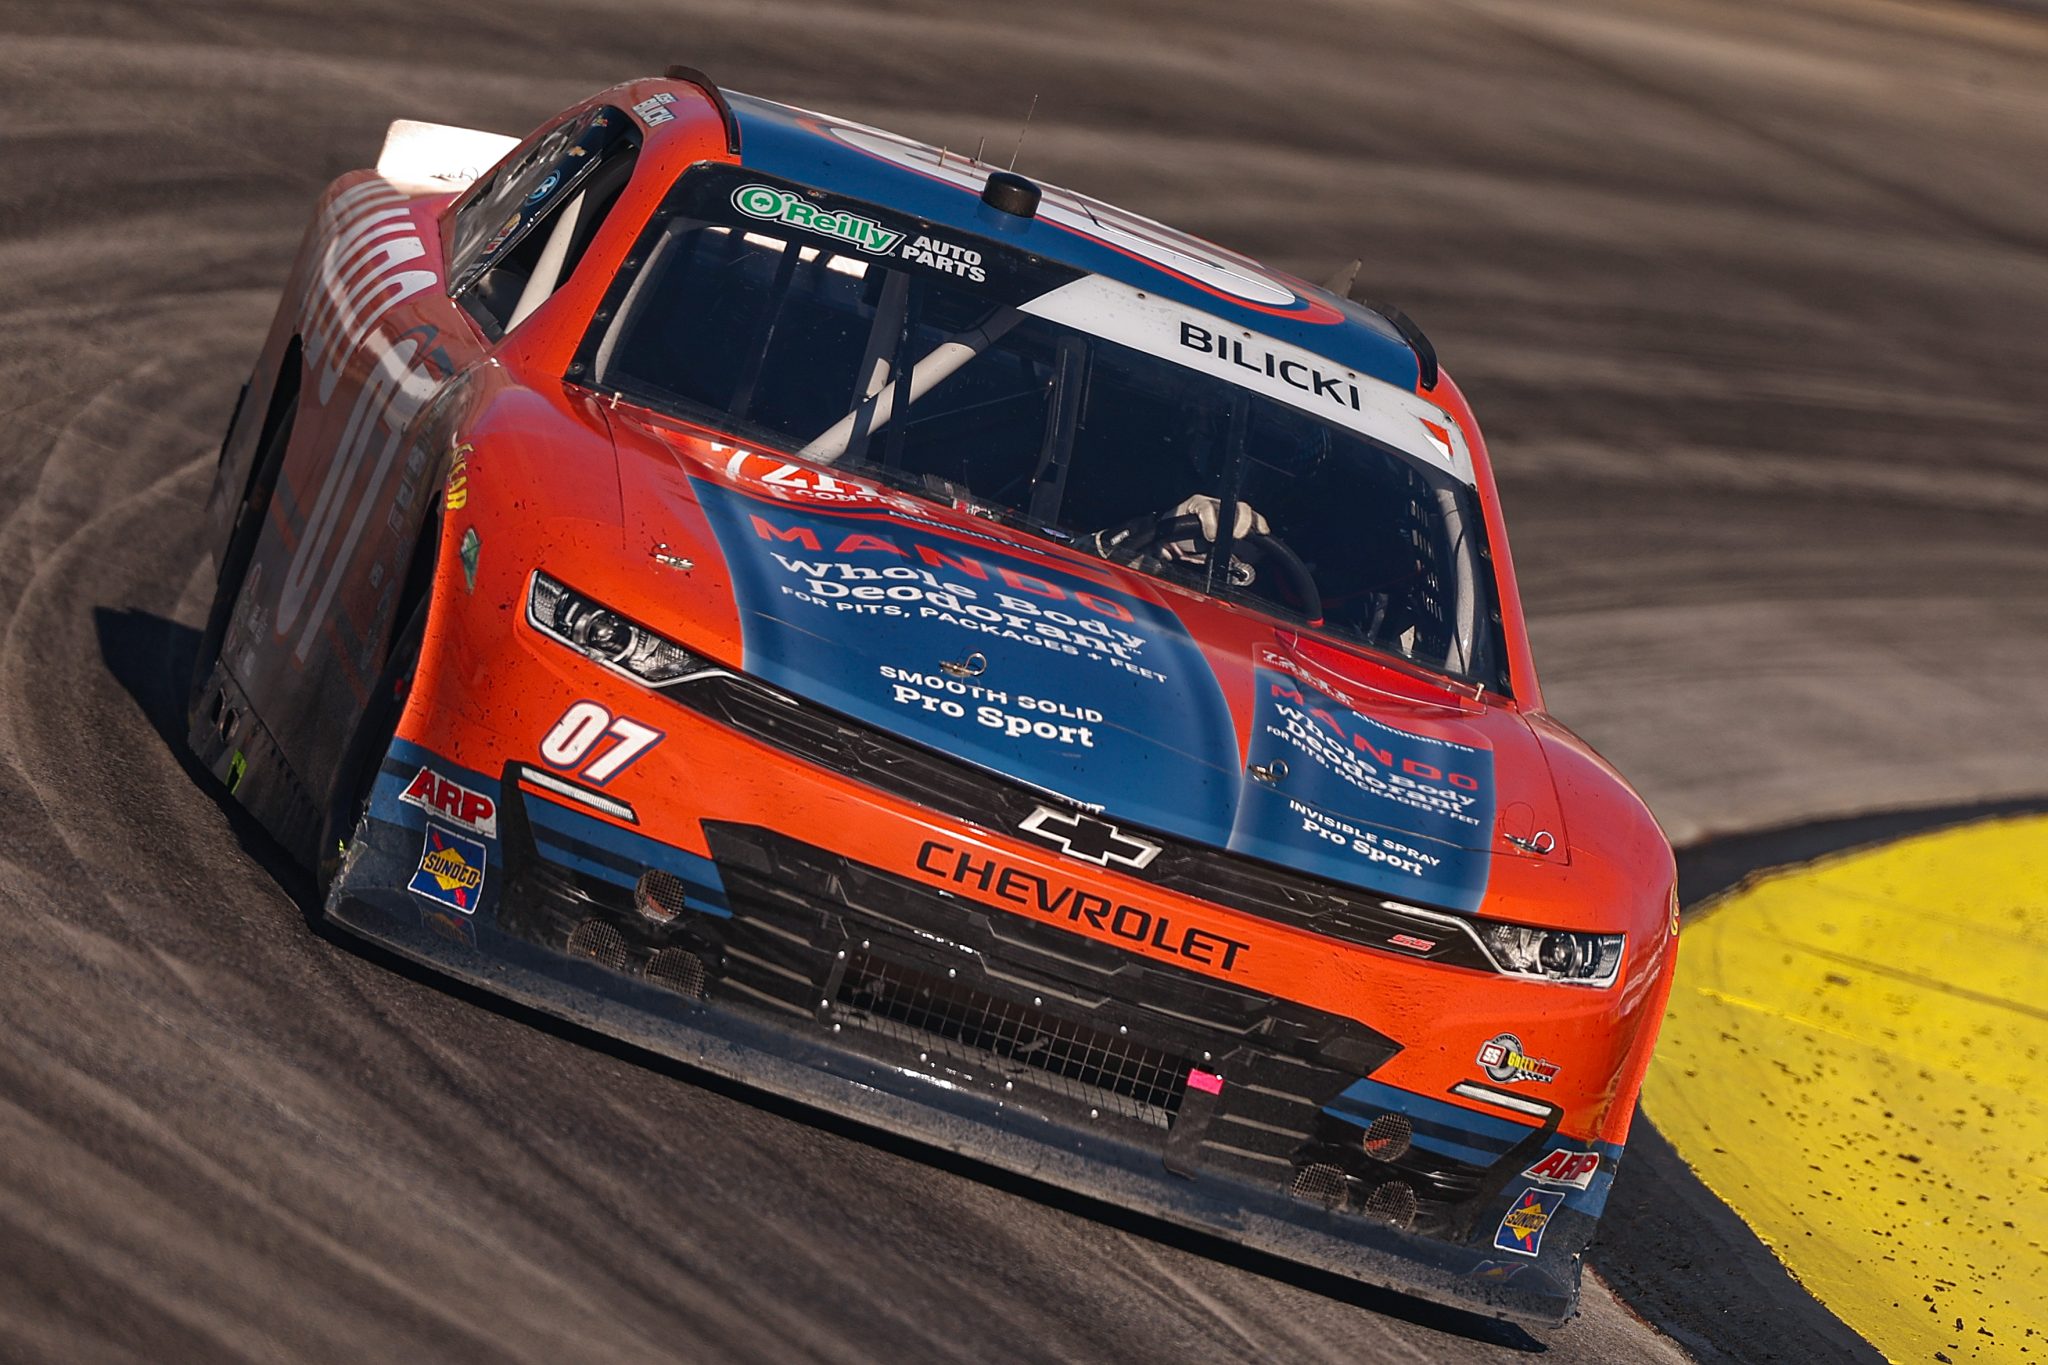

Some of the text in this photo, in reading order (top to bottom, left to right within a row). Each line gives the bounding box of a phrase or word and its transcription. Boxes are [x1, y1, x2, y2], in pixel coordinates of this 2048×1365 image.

[738, 187, 896, 252] O'Reilly
[913, 235, 982, 266] AUTO
[902, 245, 986, 283] PARTS
[1180, 321, 1360, 411] BILICKI
[749, 514, 1136, 623] MANDO
[770, 552, 1147, 649] Whole Body
[781, 586, 829, 608] FOR
[836, 602, 910, 618] PITS,
[919, 607, 1079, 655] PACKAGES
[1110, 657, 1167, 683] FEET
[805, 578, 1132, 660] Deodorant
[880, 665, 1103, 723] SMOOTH SOLID
[892, 684, 1094, 748] Pro Sport
[1352, 710, 1442, 745] Aluminum
[540, 700, 666, 787] 07
[1271, 684, 1478, 791] MANDO
[1275, 703, 1476, 806] Whole Body
[1286, 719, 1463, 813] Deodorant
[406, 769, 494, 825] ARP
[1266, 725, 1290, 741] FOR
[1335, 766, 1433, 811] PACKAGES
[1450, 812, 1480, 826] FEET
[425, 853, 479, 886] SUNOCO
[1289, 799, 1441, 866] INVISIBLE SPRAY
[1302, 817, 1423, 876] Pro Sport
[916, 840, 1250, 971] CHEVROLET
[1530, 1151, 1599, 1180] ARP
